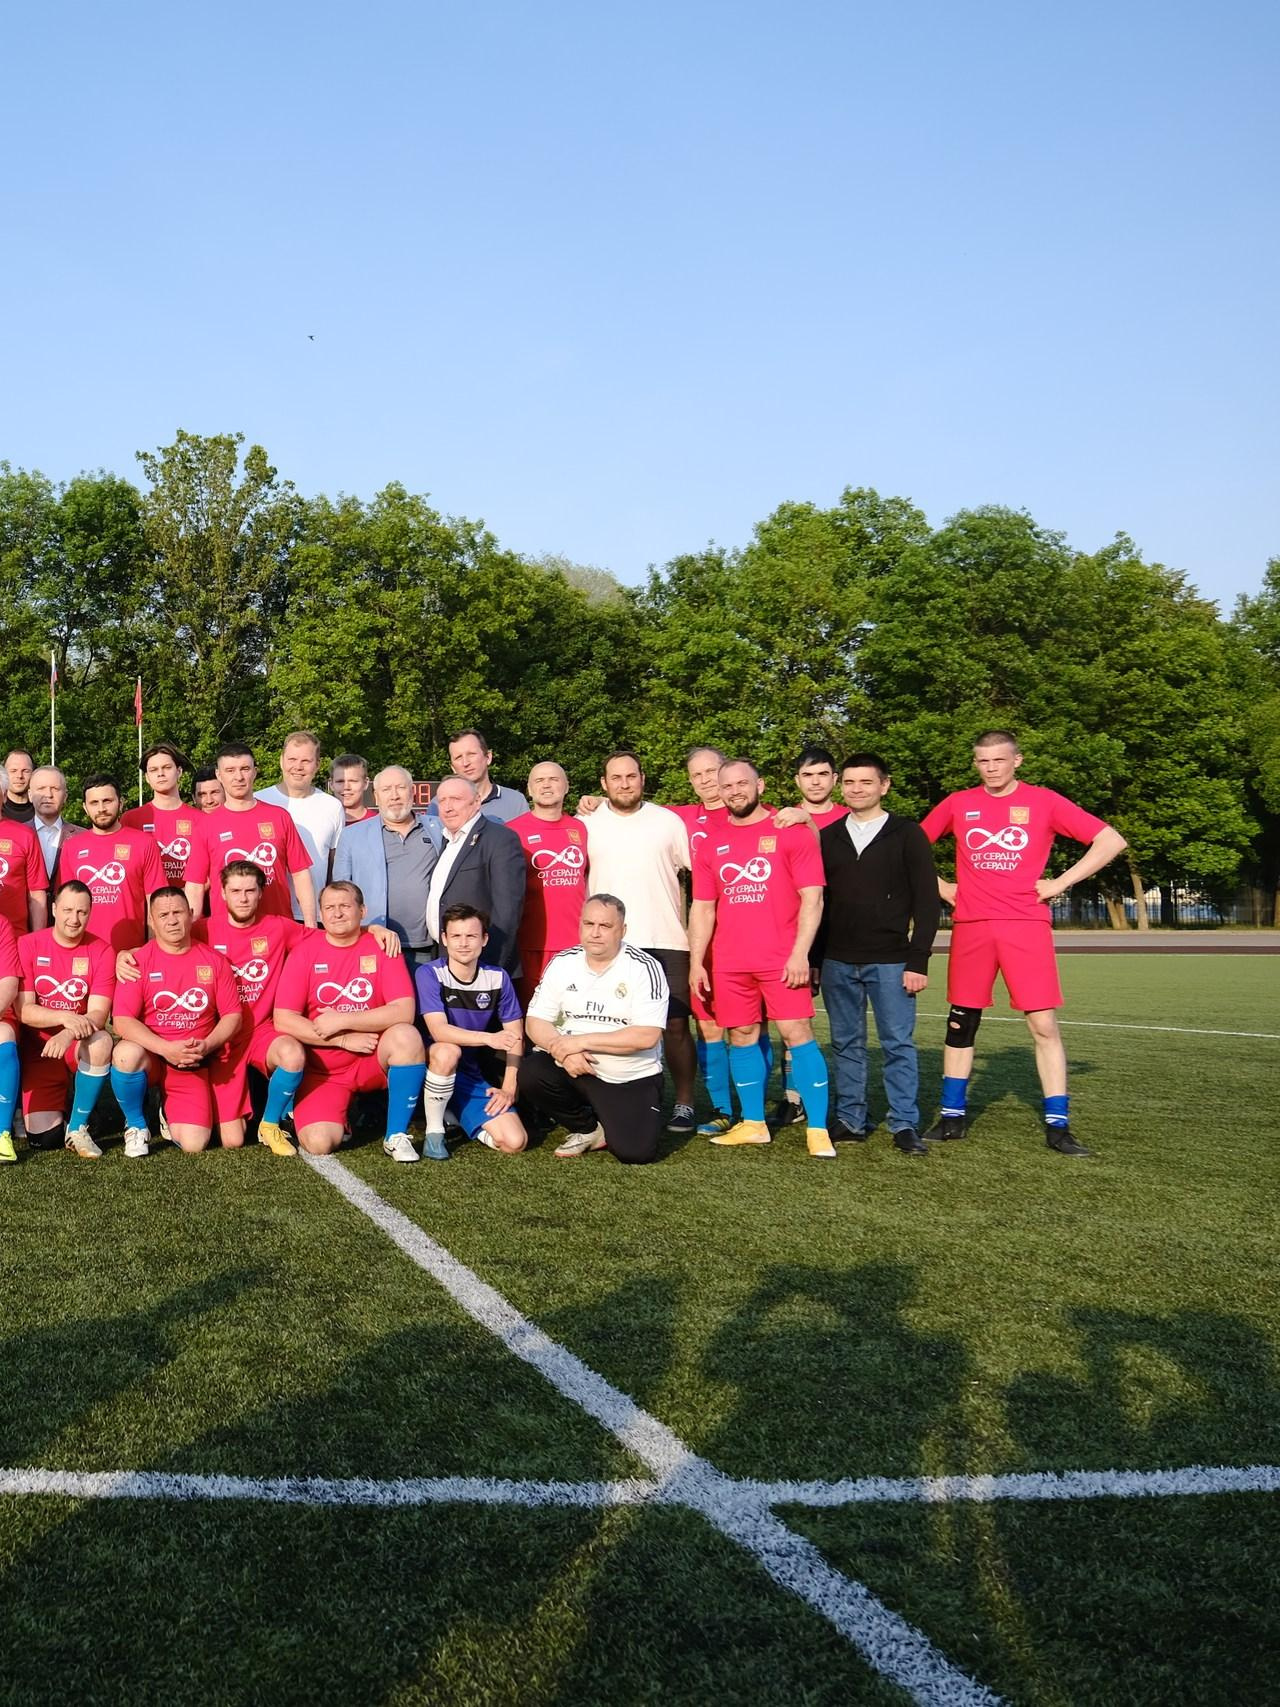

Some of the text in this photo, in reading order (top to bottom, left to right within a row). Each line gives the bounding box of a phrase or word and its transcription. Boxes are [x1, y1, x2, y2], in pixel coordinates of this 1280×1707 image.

[983, 852, 1022, 862] СЕРДЦА
[980, 862, 1017, 871] СЕРДЦУ
[551, 869, 580, 878] СЕРДЦА
[550, 878, 578, 887] СЕРДЦУ
[91, 886, 121, 894] СЕРДЦА
[724, 884, 767, 895] ОТ СЕРДЦА
[734, 894, 764, 904] СЕРДЦУ
[237, 983, 263, 992] ЕРДЦА
[50, 1000, 81, 1010] СЕРДЦА
[337, 1003, 369, 1012] СЕРДЦА
[586, 1001, 604, 1014] Fly
[157, 1013, 168, 1021] ОТ
